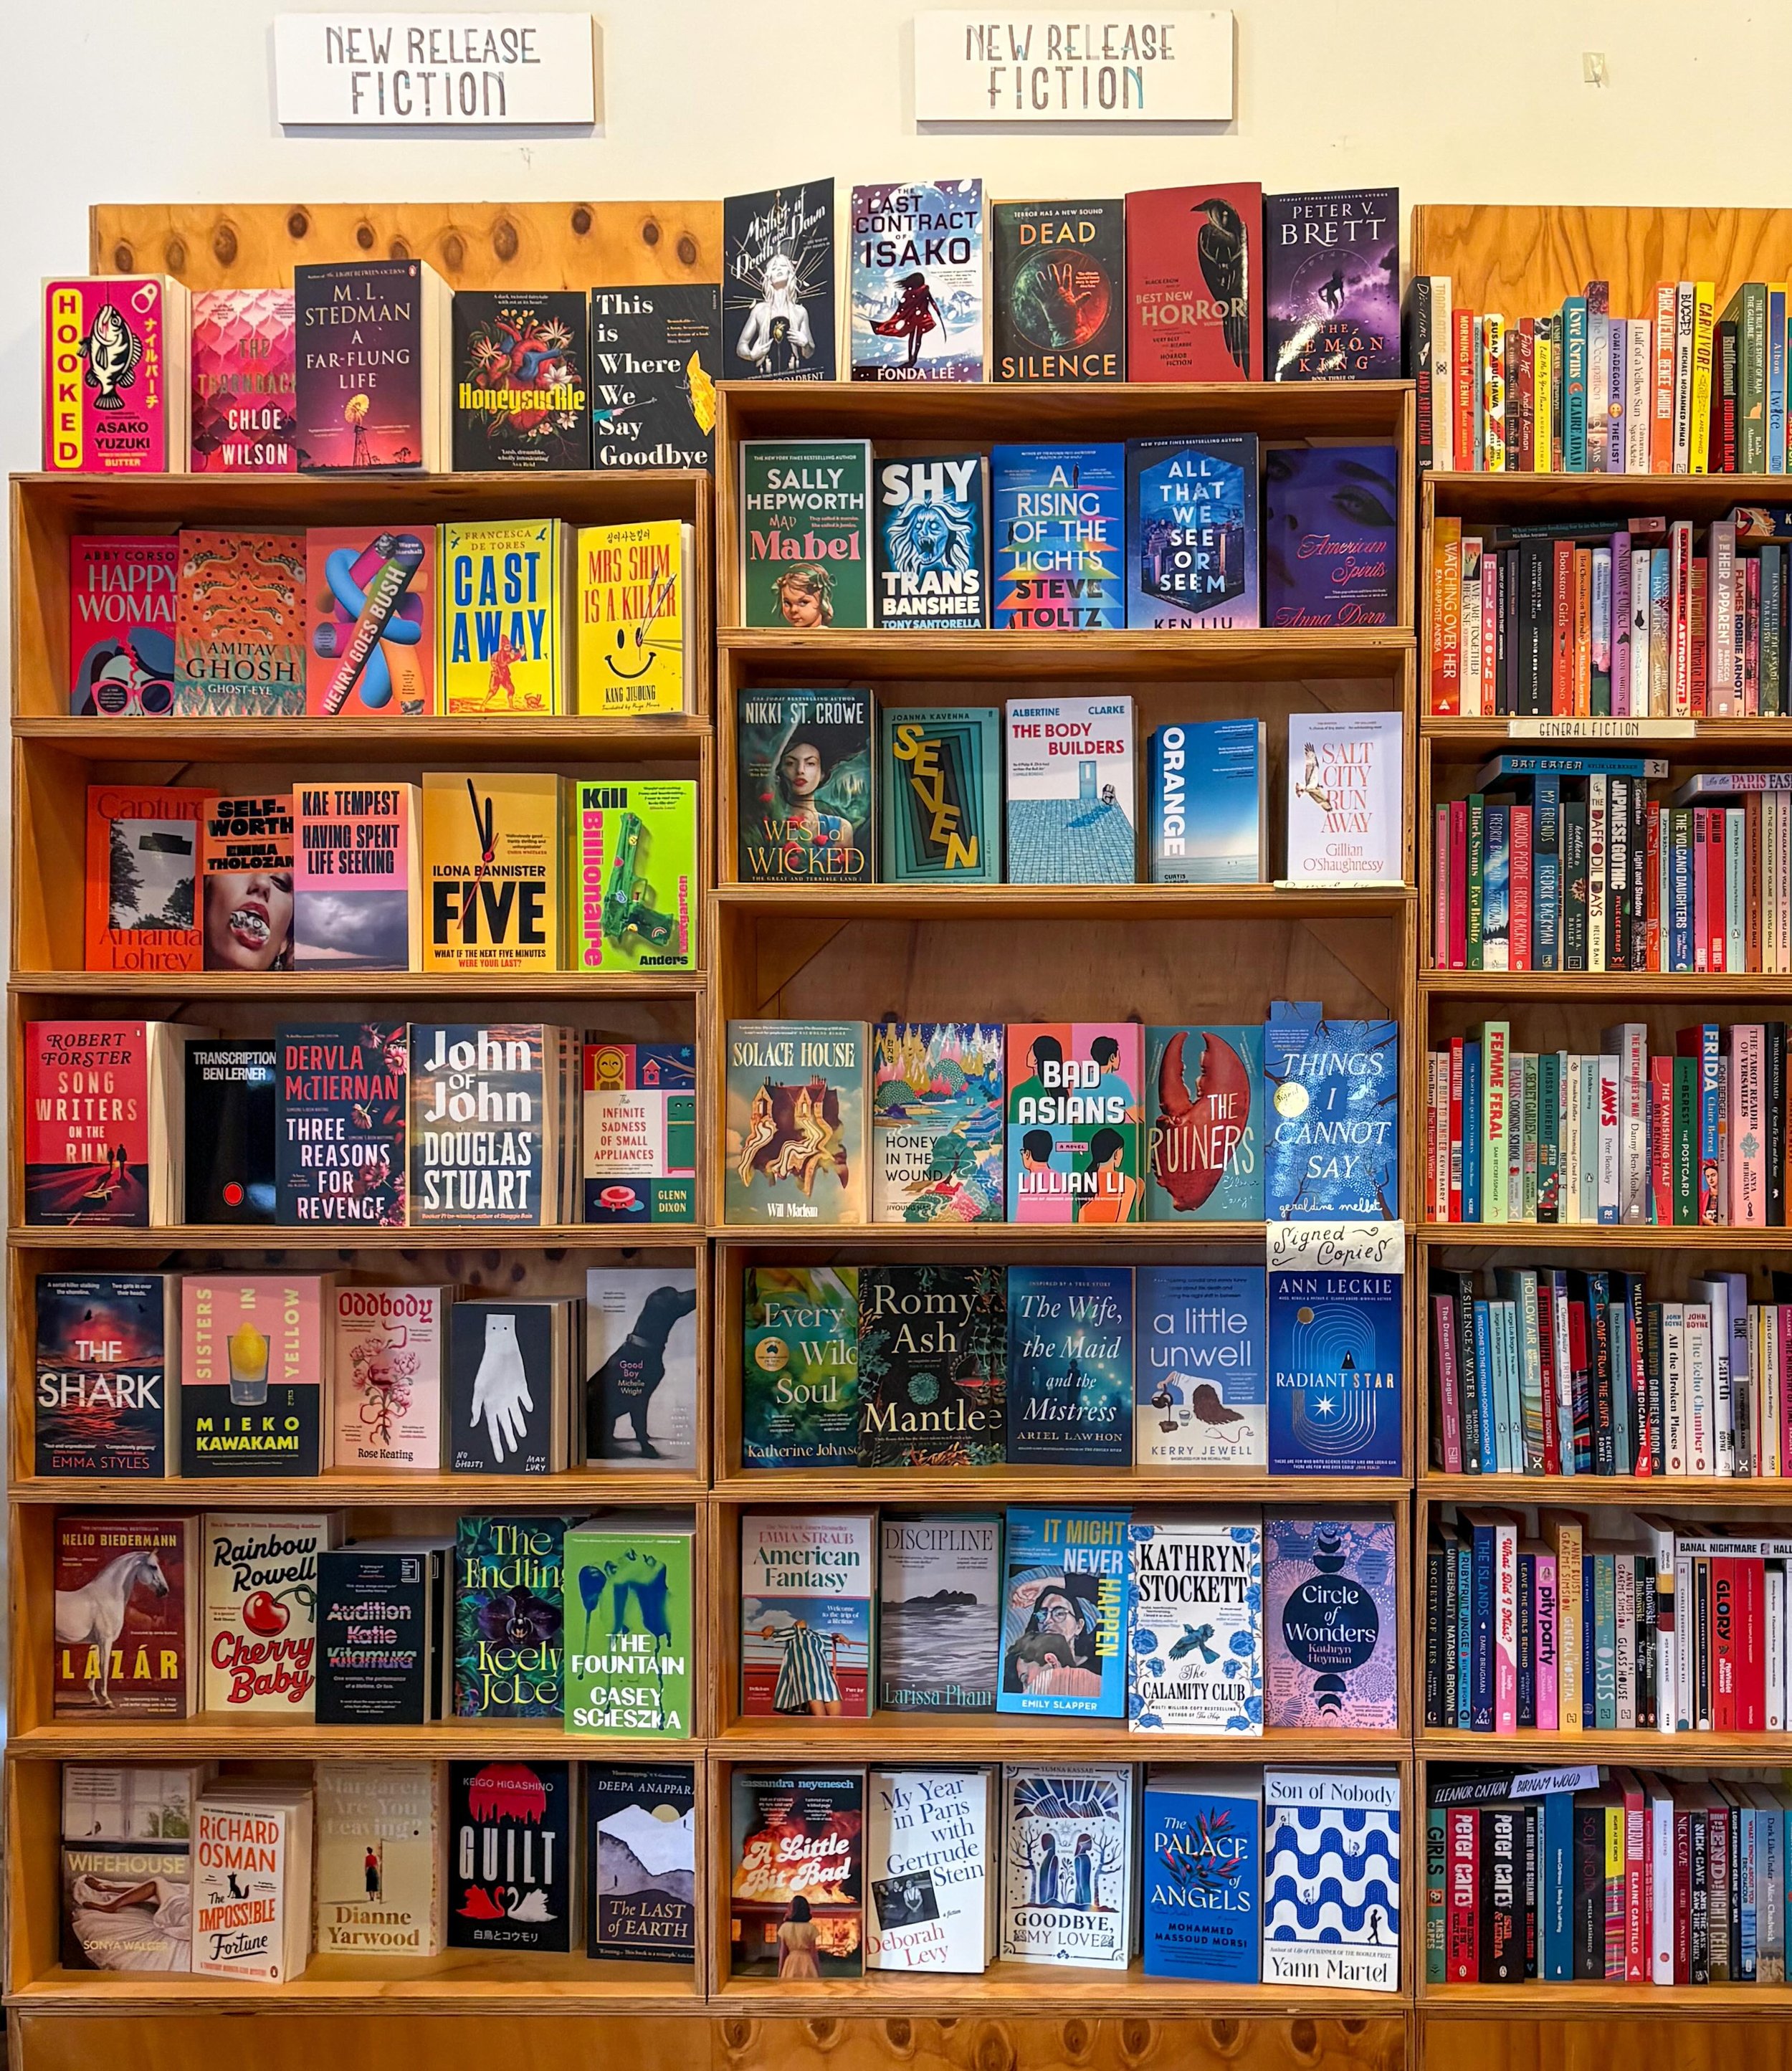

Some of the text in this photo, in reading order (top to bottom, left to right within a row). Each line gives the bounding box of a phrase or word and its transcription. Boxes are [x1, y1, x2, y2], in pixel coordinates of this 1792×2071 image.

[326, 26, 541, 66] NEW RELEASE
[966, 24, 1176, 60] NEW RELEASE
[352, 70, 506, 118] FICTION
[988, 67, 1143, 110] FICTION
[1281, 218, 1386, 246] BRETT
[866, 238, 971, 267] ISAKO
[305, 303, 411, 328] STEDMAN
[1141, 296, 1247, 326] HORROR
[1697, 303, 1712, 373] CARNIVORE
[306, 348, 410, 370] FAR-FLUNG
[1001, 354, 1116, 379] SILENCE
[58, 295, 78, 461] HOOKED
[877, 368, 955, 380] FONDA LEE
[459, 383, 586, 414] Honeysuckle
[97, 422, 148, 434] ASAKO
[228, 408, 281, 430] CHLOE
[95, 437, 150, 450] YUZUKI
[222, 443, 287, 465] WILSON
[105, 458, 140, 467] BUTTER
[600, 444, 708, 469] Goodbye
[882, 460, 976, 506] SHY
[746, 493, 864, 510] HEPWORTH
[750, 530, 862, 561] Mabel
[1297, 534, 1387, 560] American
[454, 552, 541, 606] CAST
[1559, 551, 1569, 627] Bookstore Girls
[882, 596, 981, 616] BANSHEE
[1019, 606, 1102, 628] TOLTZ
[1443, 542, 1457, 678] WATCHING OVER HER
[323, 566, 407, 713] HENRY GOES BUSH
[186, 659, 296, 682] GHOSH
[207, 683, 273, 695] GHOST-EYE
[606, 685, 655, 703] KANG JIYOUNG
[746, 703, 864, 725] NIKKI ST. CROWE
[1012, 705, 1125, 718] ALBERTINE CLARKE
[1539, 721, 1639, 736] GENERAL FICTION
[1048, 739, 1125, 757] BUILDERS
[1511, 760, 1583, 770] BAT EATER
[302, 791, 400, 816] KAE TEMPEST
[1163, 726, 1185, 857] ORANGE
[217, 799, 286, 818] SELF-
[226, 843, 278, 857] EMMA
[747, 847, 864, 875] WICKED
[432, 865, 545, 877] ILONA BANNISTER
[1303, 857, 1384, 874] O'Shaughnessy
[1675, 814, 1687, 929] THE VOLCANO DAUGHTERS
[583, 811, 604, 967] Billionaire
[433, 881, 546, 945] FIVE
[112, 946, 194, 972] Lohrey
[639, 955, 688, 966] Anders
[41, 1050, 132, 1068] FORSTER
[193, 1051, 277, 1066] TRANSCRIPTION
[733, 1042, 857, 1067] SOLACE HOUSE
[1282, 1052, 1385, 1077] THINGS
[1704, 1031, 1719, 1092] FRIDA
[1489, 1032, 1505, 1141] FEMME FERAL
[36, 1098, 138, 1121] WRITERS
[1018, 1096, 1126, 1125] ASIANS
[1601, 1077, 1617, 1127] JAWS
[594, 1149, 654, 1161] APPLIANCES
[1147, 1125, 1255, 1177] RUINERS
[886, 1169, 943, 1182] WOUND
[424, 1169, 531, 1211] STUART
[658, 1201, 687, 1213] DIXON
[1274, 1225, 1345, 1254] Signed
[1317, 1238, 1393, 1265] Copies
[1279, 1279, 1392, 1294] ANN LECKIE
[339, 1292, 433, 1323] Oddbody
[874, 1284, 978, 1328] Romy
[1524, 1277, 1536, 1344] HOLLOW AIR
[285, 1288, 300, 1378] YELLOW
[1150, 1341, 1252, 1368] unwell
[38, 1373, 161, 1409] SHARK
[1023, 1397, 1117, 1422] Mistress
[196, 1436, 300, 1451] KAWAKAMI
[1152, 1445, 1252, 1455] KERRY JEWELL
[52, 1456, 150, 1470] EMMA STYLES
[454, 1460, 484, 1470] GHOSTS
[62, 1534, 176, 1548] NELIO BIEDERMANN
[213, 1533, 317, 1568] Rainbow
[885, 1528, 993, 1553] DISCIPLINE
[1680, 1543, 1757, 1553] BANAL NIGHTMARE
[754, 1545, 860, 1567] American
[1064, 1548, 1123, 1574] NEVER
[1139, 1543, 1246, 1574] KATHRYN
[1716, 1580, 1731, 1641] GLORY
[1285, 1622, 1377, 1644] Wonders
[480, 1673, 559, 1712] Jobe
[573, 1709, 682, 1730] SCIESZKA
[1270, 1781, 1396, 1807] Son of Nobody
[1435, 1781, 1508, 1802] ELEANOR CATTON
[1517, 1773, 1581, 1792] BIRNAM WOOD
[199, 1842, 276, 1873] OSMAN
[459, 1825, 556, 1885] GUILT
[886, 1842, 980, 1875] Gertrude
[1427, 1827, 1444, 1875] GIRLS
[69, 1853, 186, 1875] WIFEHOUSE
[1151, 1883, 1251, 1913] ANGELS
[326, 1927, 419, 1946] Yarwood
[474, 1930, 538, 1942] 白鳥とコウモリ
[607, 1920, 687, 1938] of EARTH
